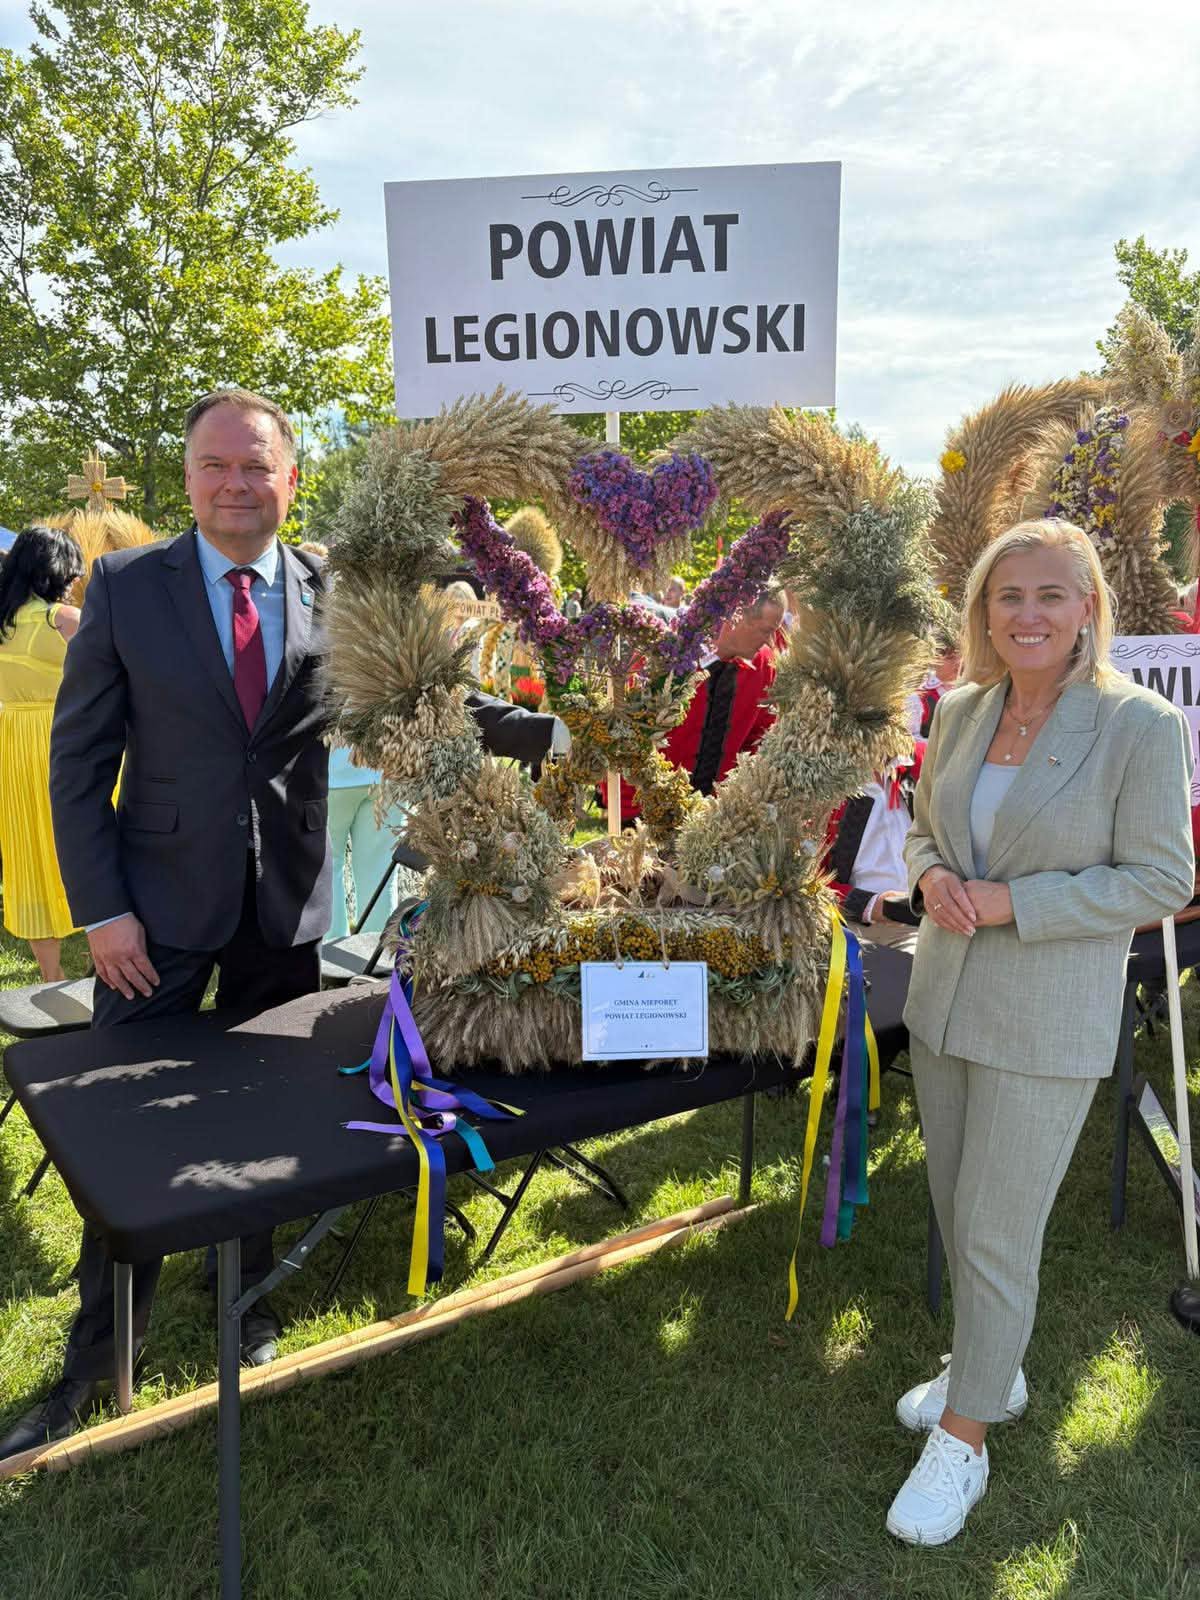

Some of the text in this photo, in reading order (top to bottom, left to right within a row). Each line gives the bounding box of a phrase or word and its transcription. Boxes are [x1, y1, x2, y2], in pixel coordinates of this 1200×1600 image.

[489, 213, 739, 281] POWIAT
[425, 303, 806, 364] LEGIONOWSKI
[605, 1012, 633, 1020] POWIAT
